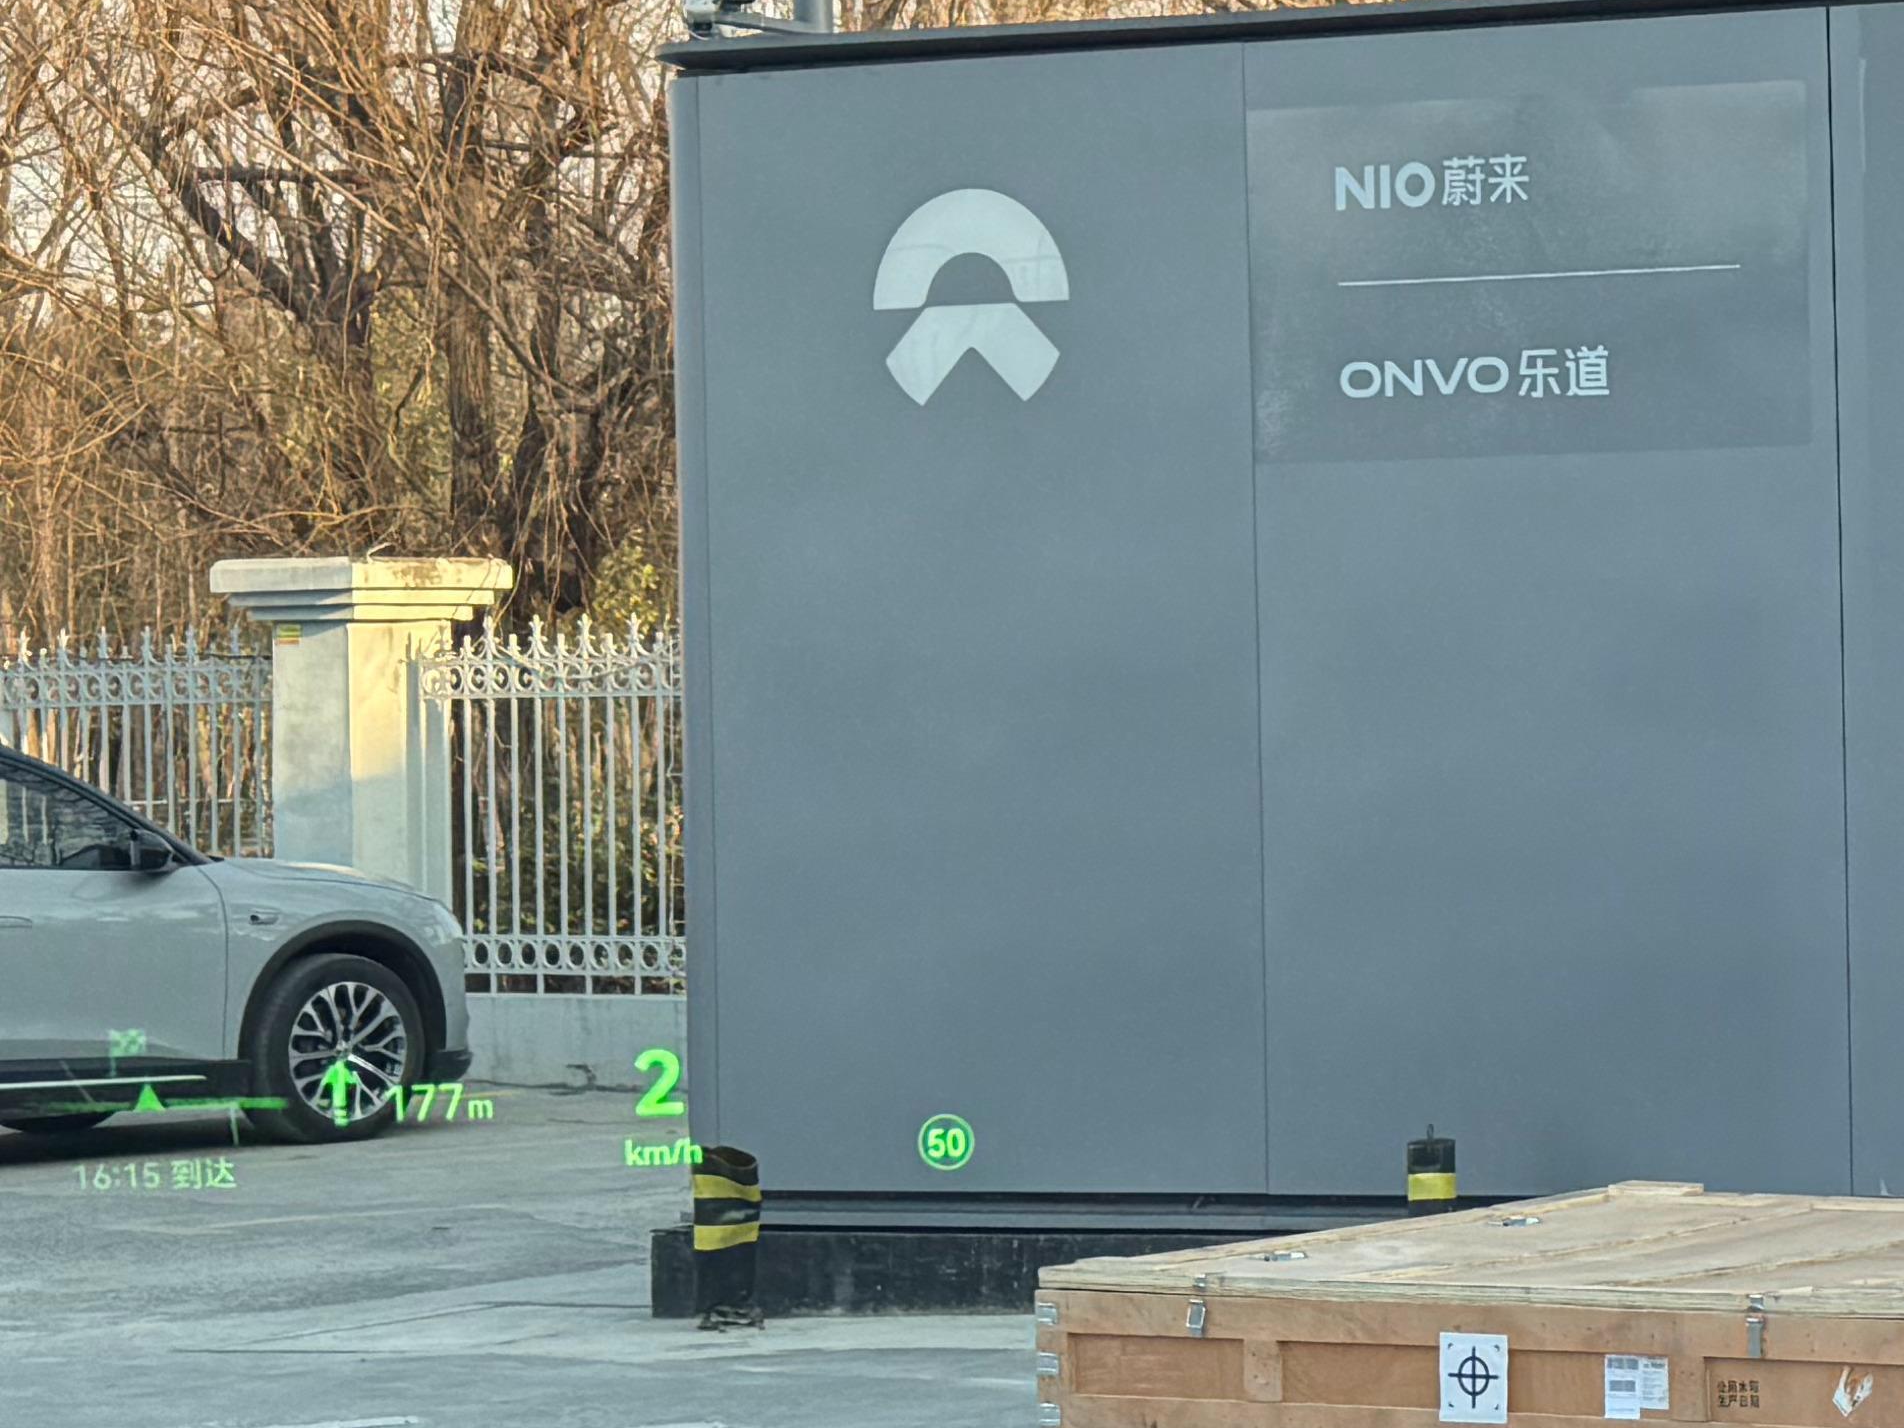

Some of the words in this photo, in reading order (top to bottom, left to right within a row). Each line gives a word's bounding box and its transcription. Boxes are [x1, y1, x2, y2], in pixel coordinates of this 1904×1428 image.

[634, 1048, 687, 1118] 2
[625, 1139, 704, 1167] km/h
[927, 1126, 966, 1161] 50
[75, 1161, 161, 1190] 16:15
[170, 1157, 237, 1189] 到达
